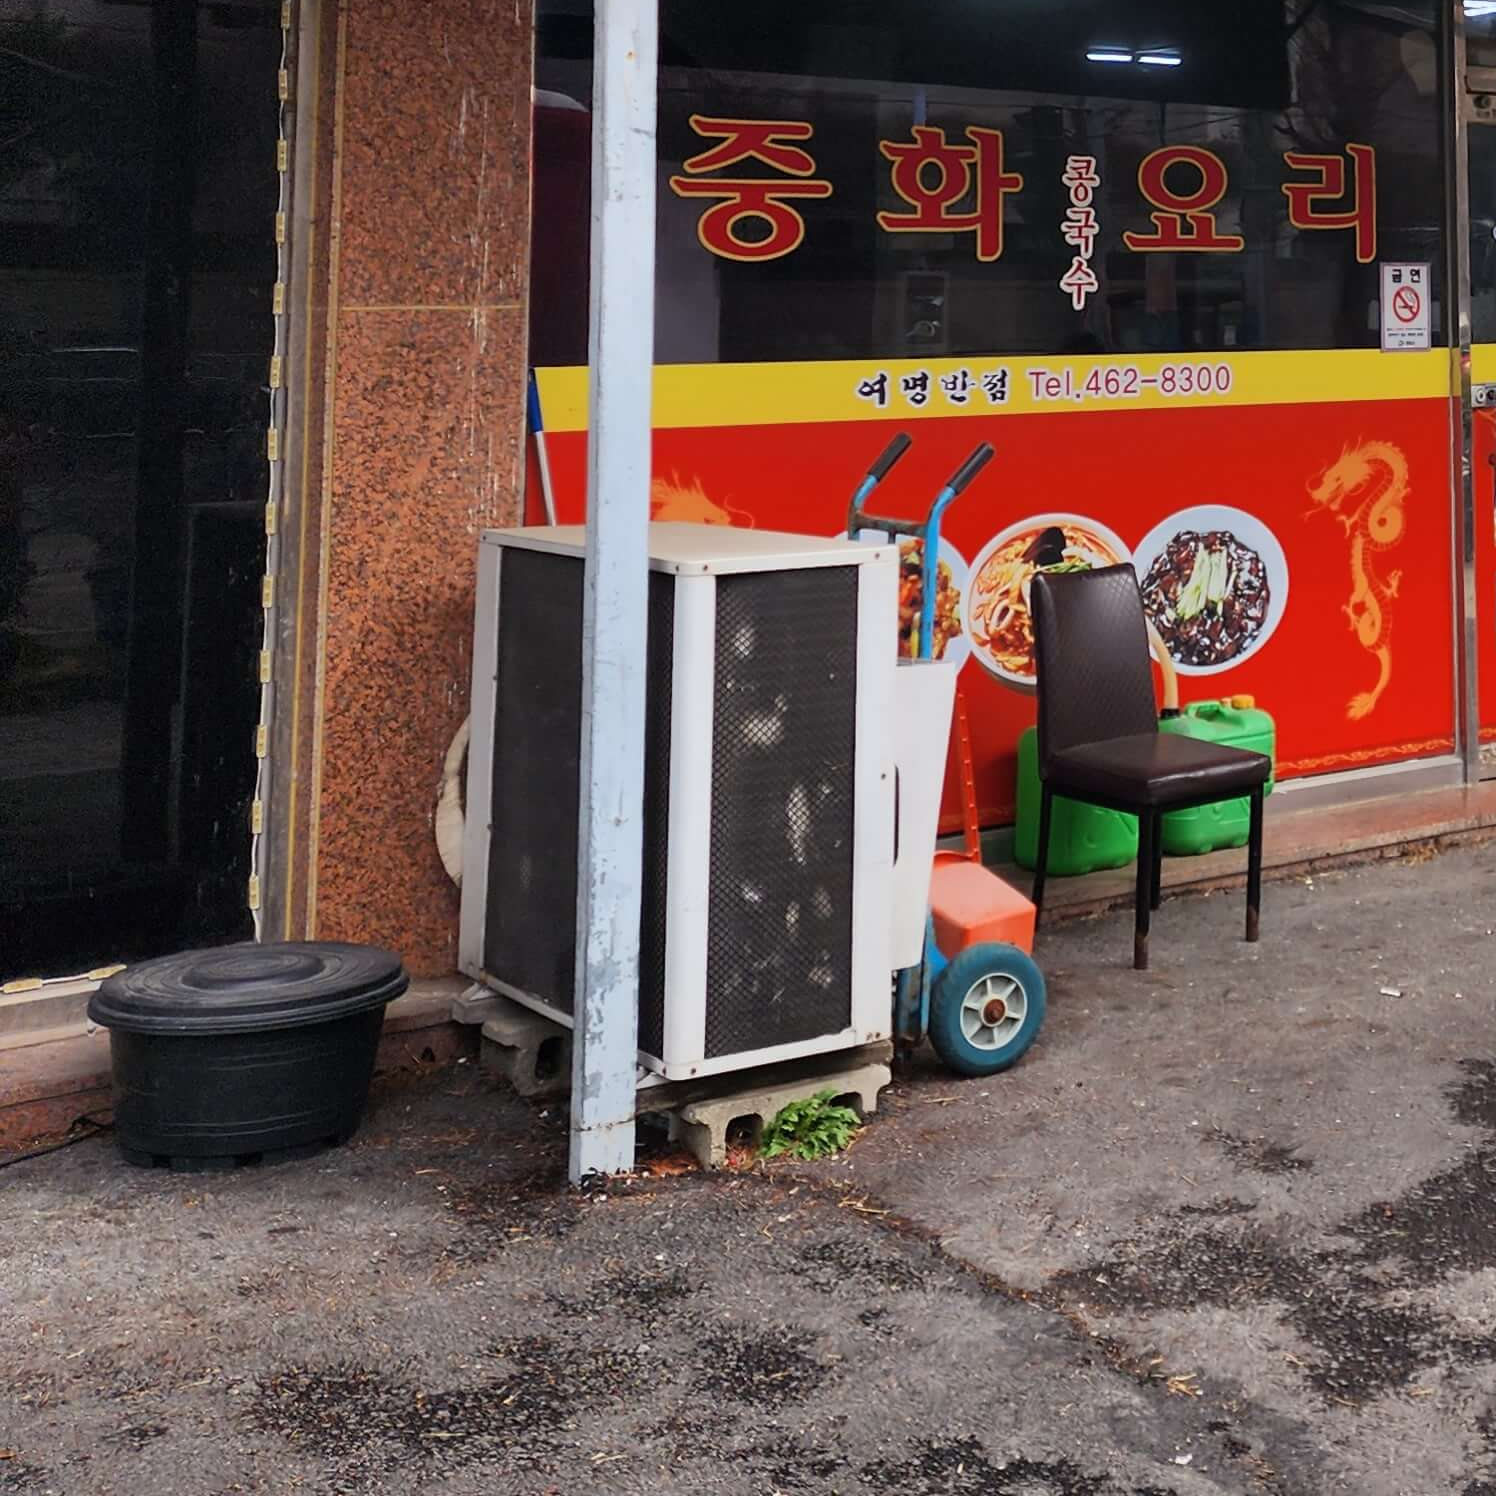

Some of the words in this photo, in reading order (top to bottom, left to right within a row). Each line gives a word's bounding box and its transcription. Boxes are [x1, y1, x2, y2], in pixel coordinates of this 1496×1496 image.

[1060, 154, 1100, 311] 콩국수
[1392, 269, 1421, 283] 금연
[856, 368, 1011, 407] 여명반점
[1028, 363, 1233, 401] Tel.462-8300
